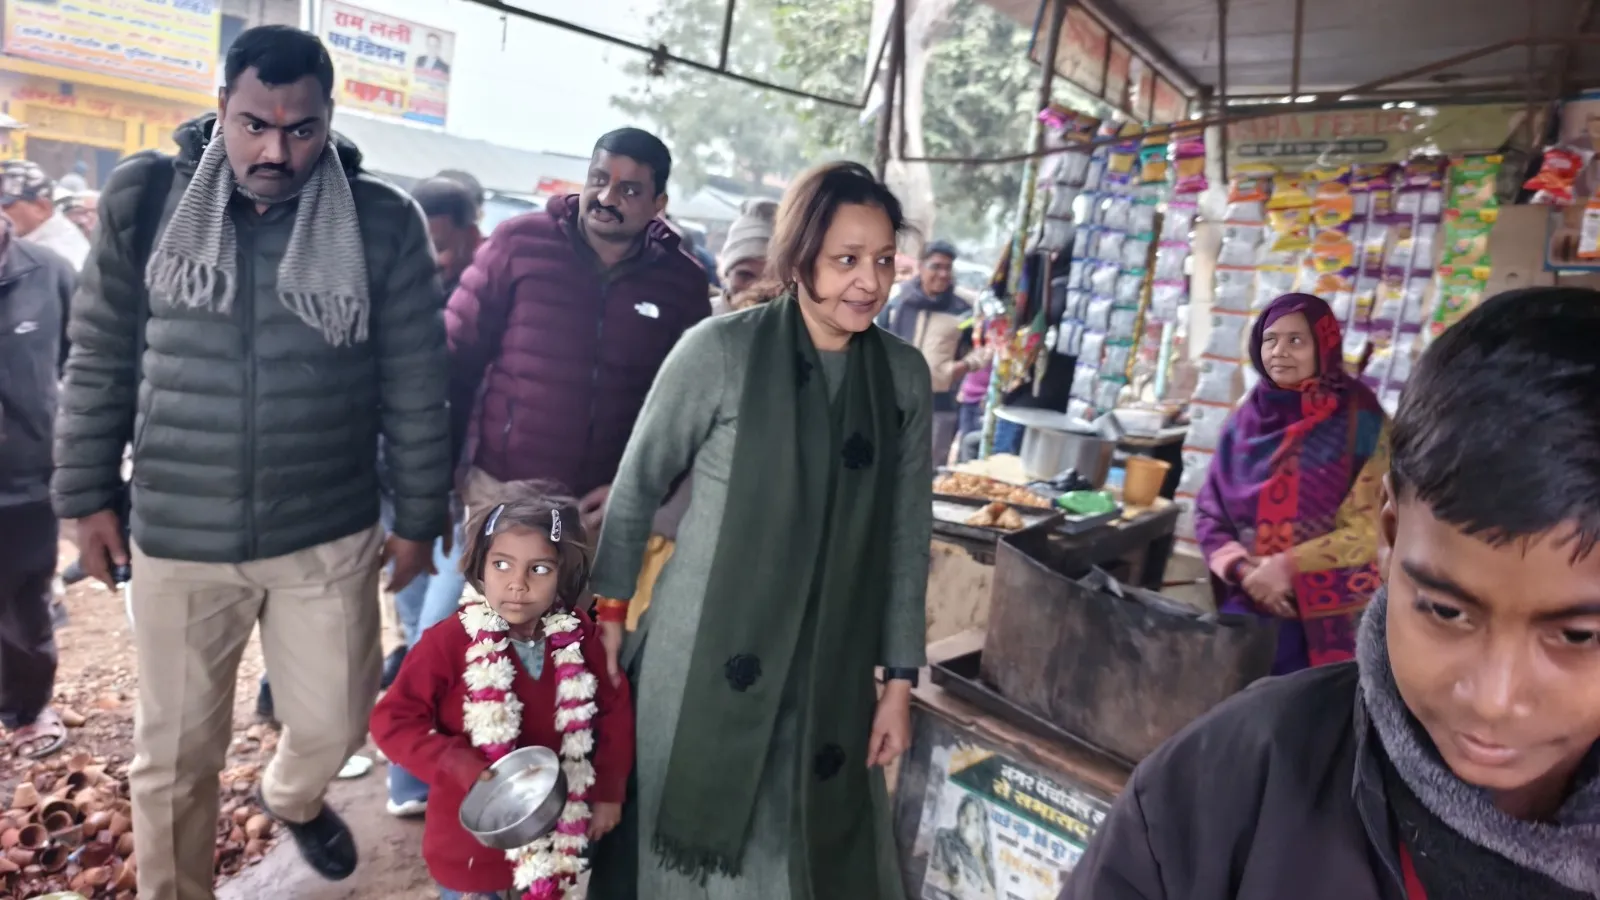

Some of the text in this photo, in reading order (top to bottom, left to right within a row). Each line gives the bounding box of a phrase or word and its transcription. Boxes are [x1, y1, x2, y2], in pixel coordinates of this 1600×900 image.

[335, 11, 364, 31] राम
[1002, 764, 1035, 790] नगर
[1036, 779, 1092, 820] पंचायत
